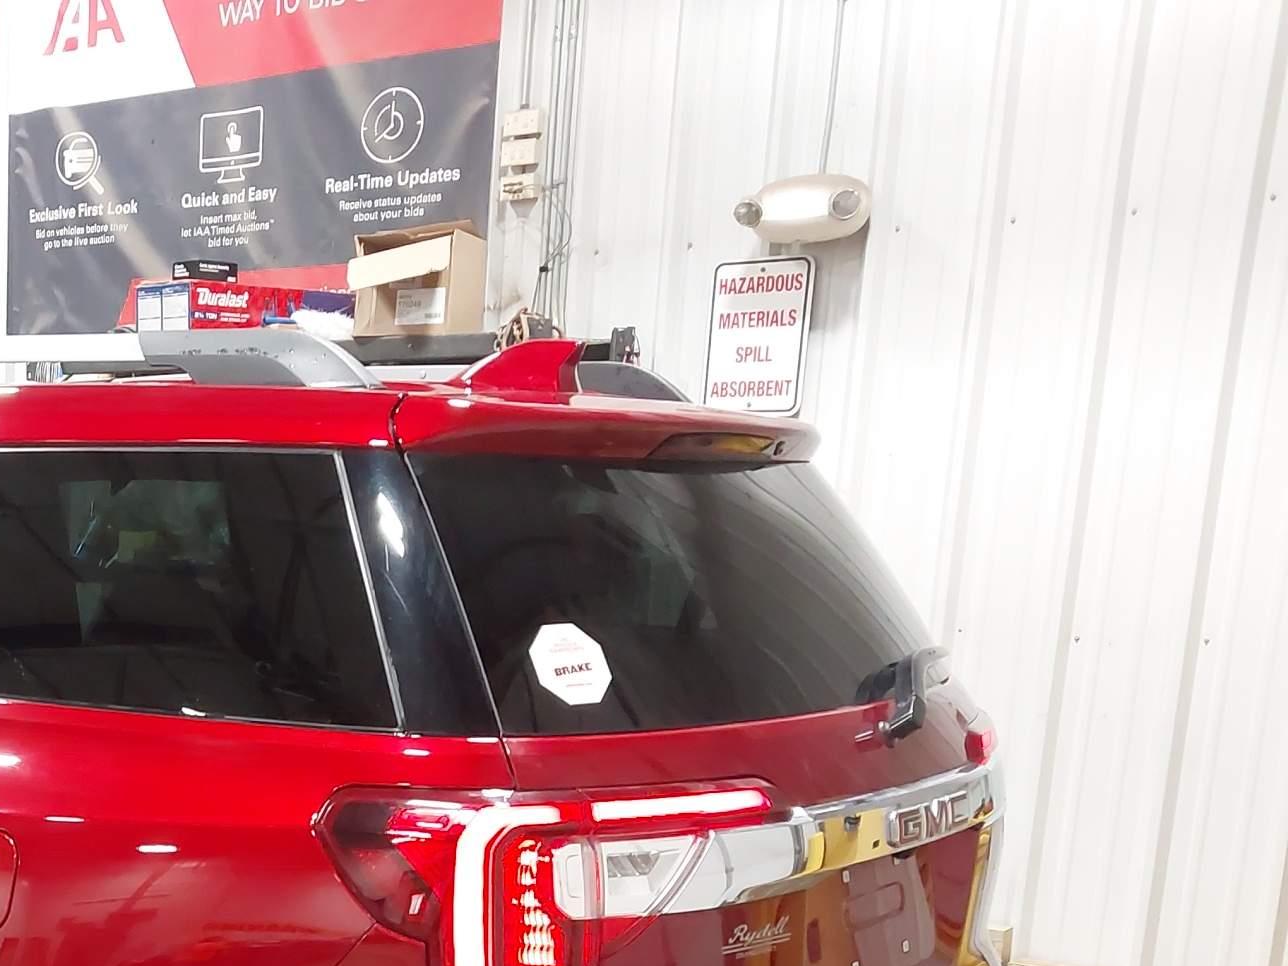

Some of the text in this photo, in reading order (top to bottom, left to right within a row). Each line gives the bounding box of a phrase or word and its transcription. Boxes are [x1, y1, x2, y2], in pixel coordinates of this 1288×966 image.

[219, 0, 263, 27] WAY
[325, 168, 461, 194] Real-Time Updates
[181, 186, 277, 208] Quick and Easy
[339, 193, 442, 211] Receive status updates
[29, 199, 138, 223] Exclusive First Look
[200, 214, 223, 224] Insert
[225, 212, 242, 222] max
[353, 206, 424, 222] about your bids
[35, 223, 128, 239] Bid on vehicles before they
[181, 227, 192, 237] let
[194, 226, 210, 237] IAA
[211, 224, 235, 235] Timed
[44, 235, 115, 251] go to the live auction
[208, 236, 249, 248] bid for you
[718, 273, 804, 296] HAZARDOUS
[196, 287, 249, 308] Duralast
[718, 309, 797, 330] MATERIALS
[735, 346, 773, 364] SPILL
[711, 379, 793, 399] ABSORBENT
[554, 662, 593, 676] BRAKE
[889, 789, 969, 846] GMC
